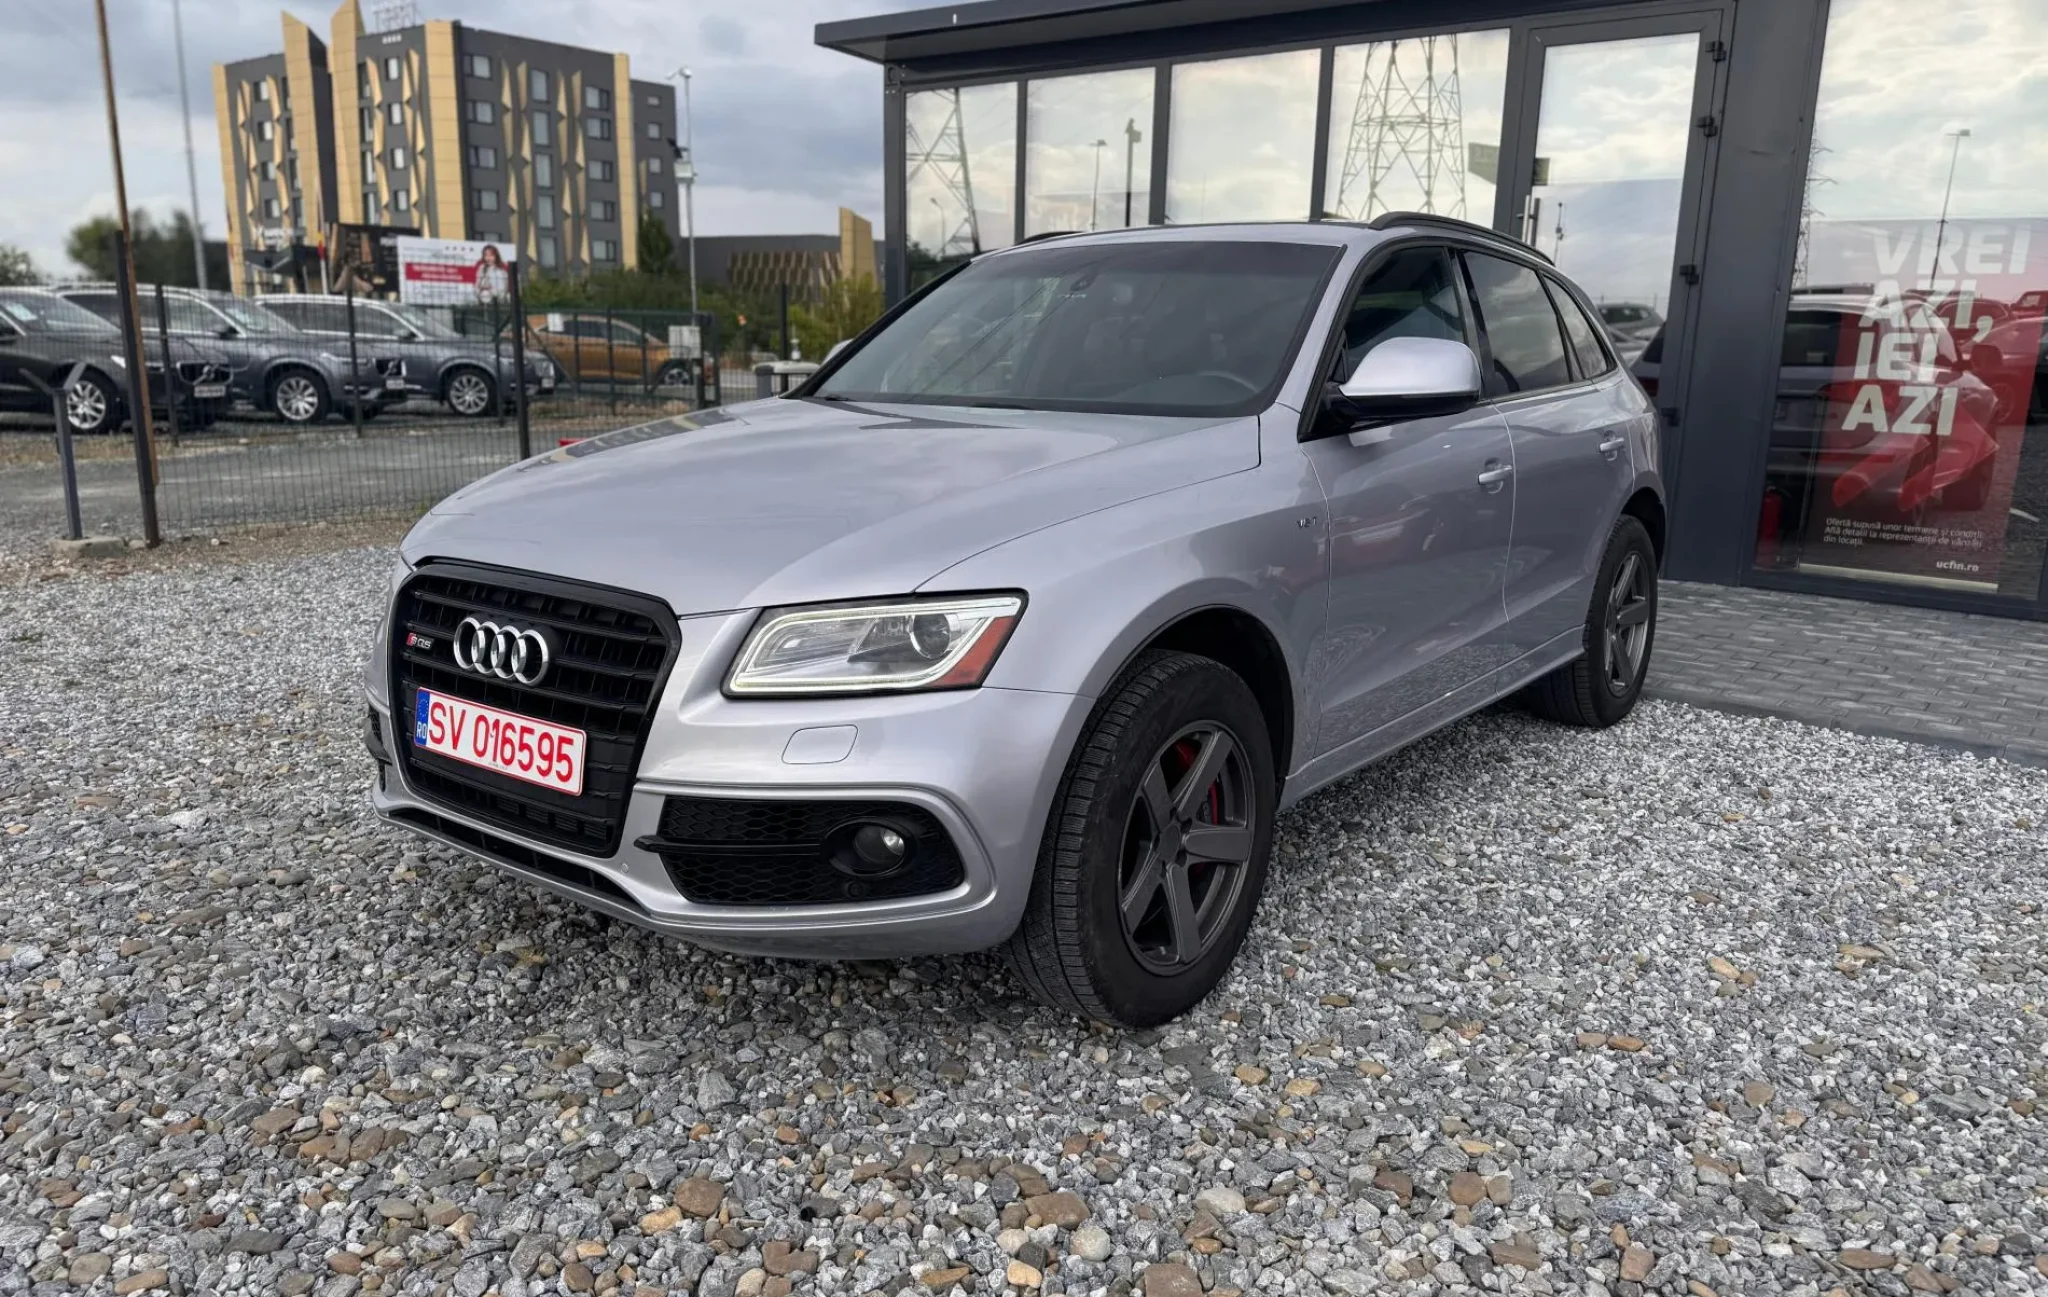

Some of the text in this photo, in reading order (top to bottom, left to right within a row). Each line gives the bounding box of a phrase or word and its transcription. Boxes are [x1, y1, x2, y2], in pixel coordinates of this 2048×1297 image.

[1874, 226, 2030, 275] VREI
[1858, 279, 1994, 343] AZI,
[1853, 332, 1939, 383] IEI
[1841, 384, 1959, 436] AZI
[1882, 523, 1902, 531] unor
[1938, 536, 1949, 545] de
[1936, 560, 1979, 572] ucfin.ro
[416, 721, 428, 740] RO
[429, 701, 575, 783] SV 016595
